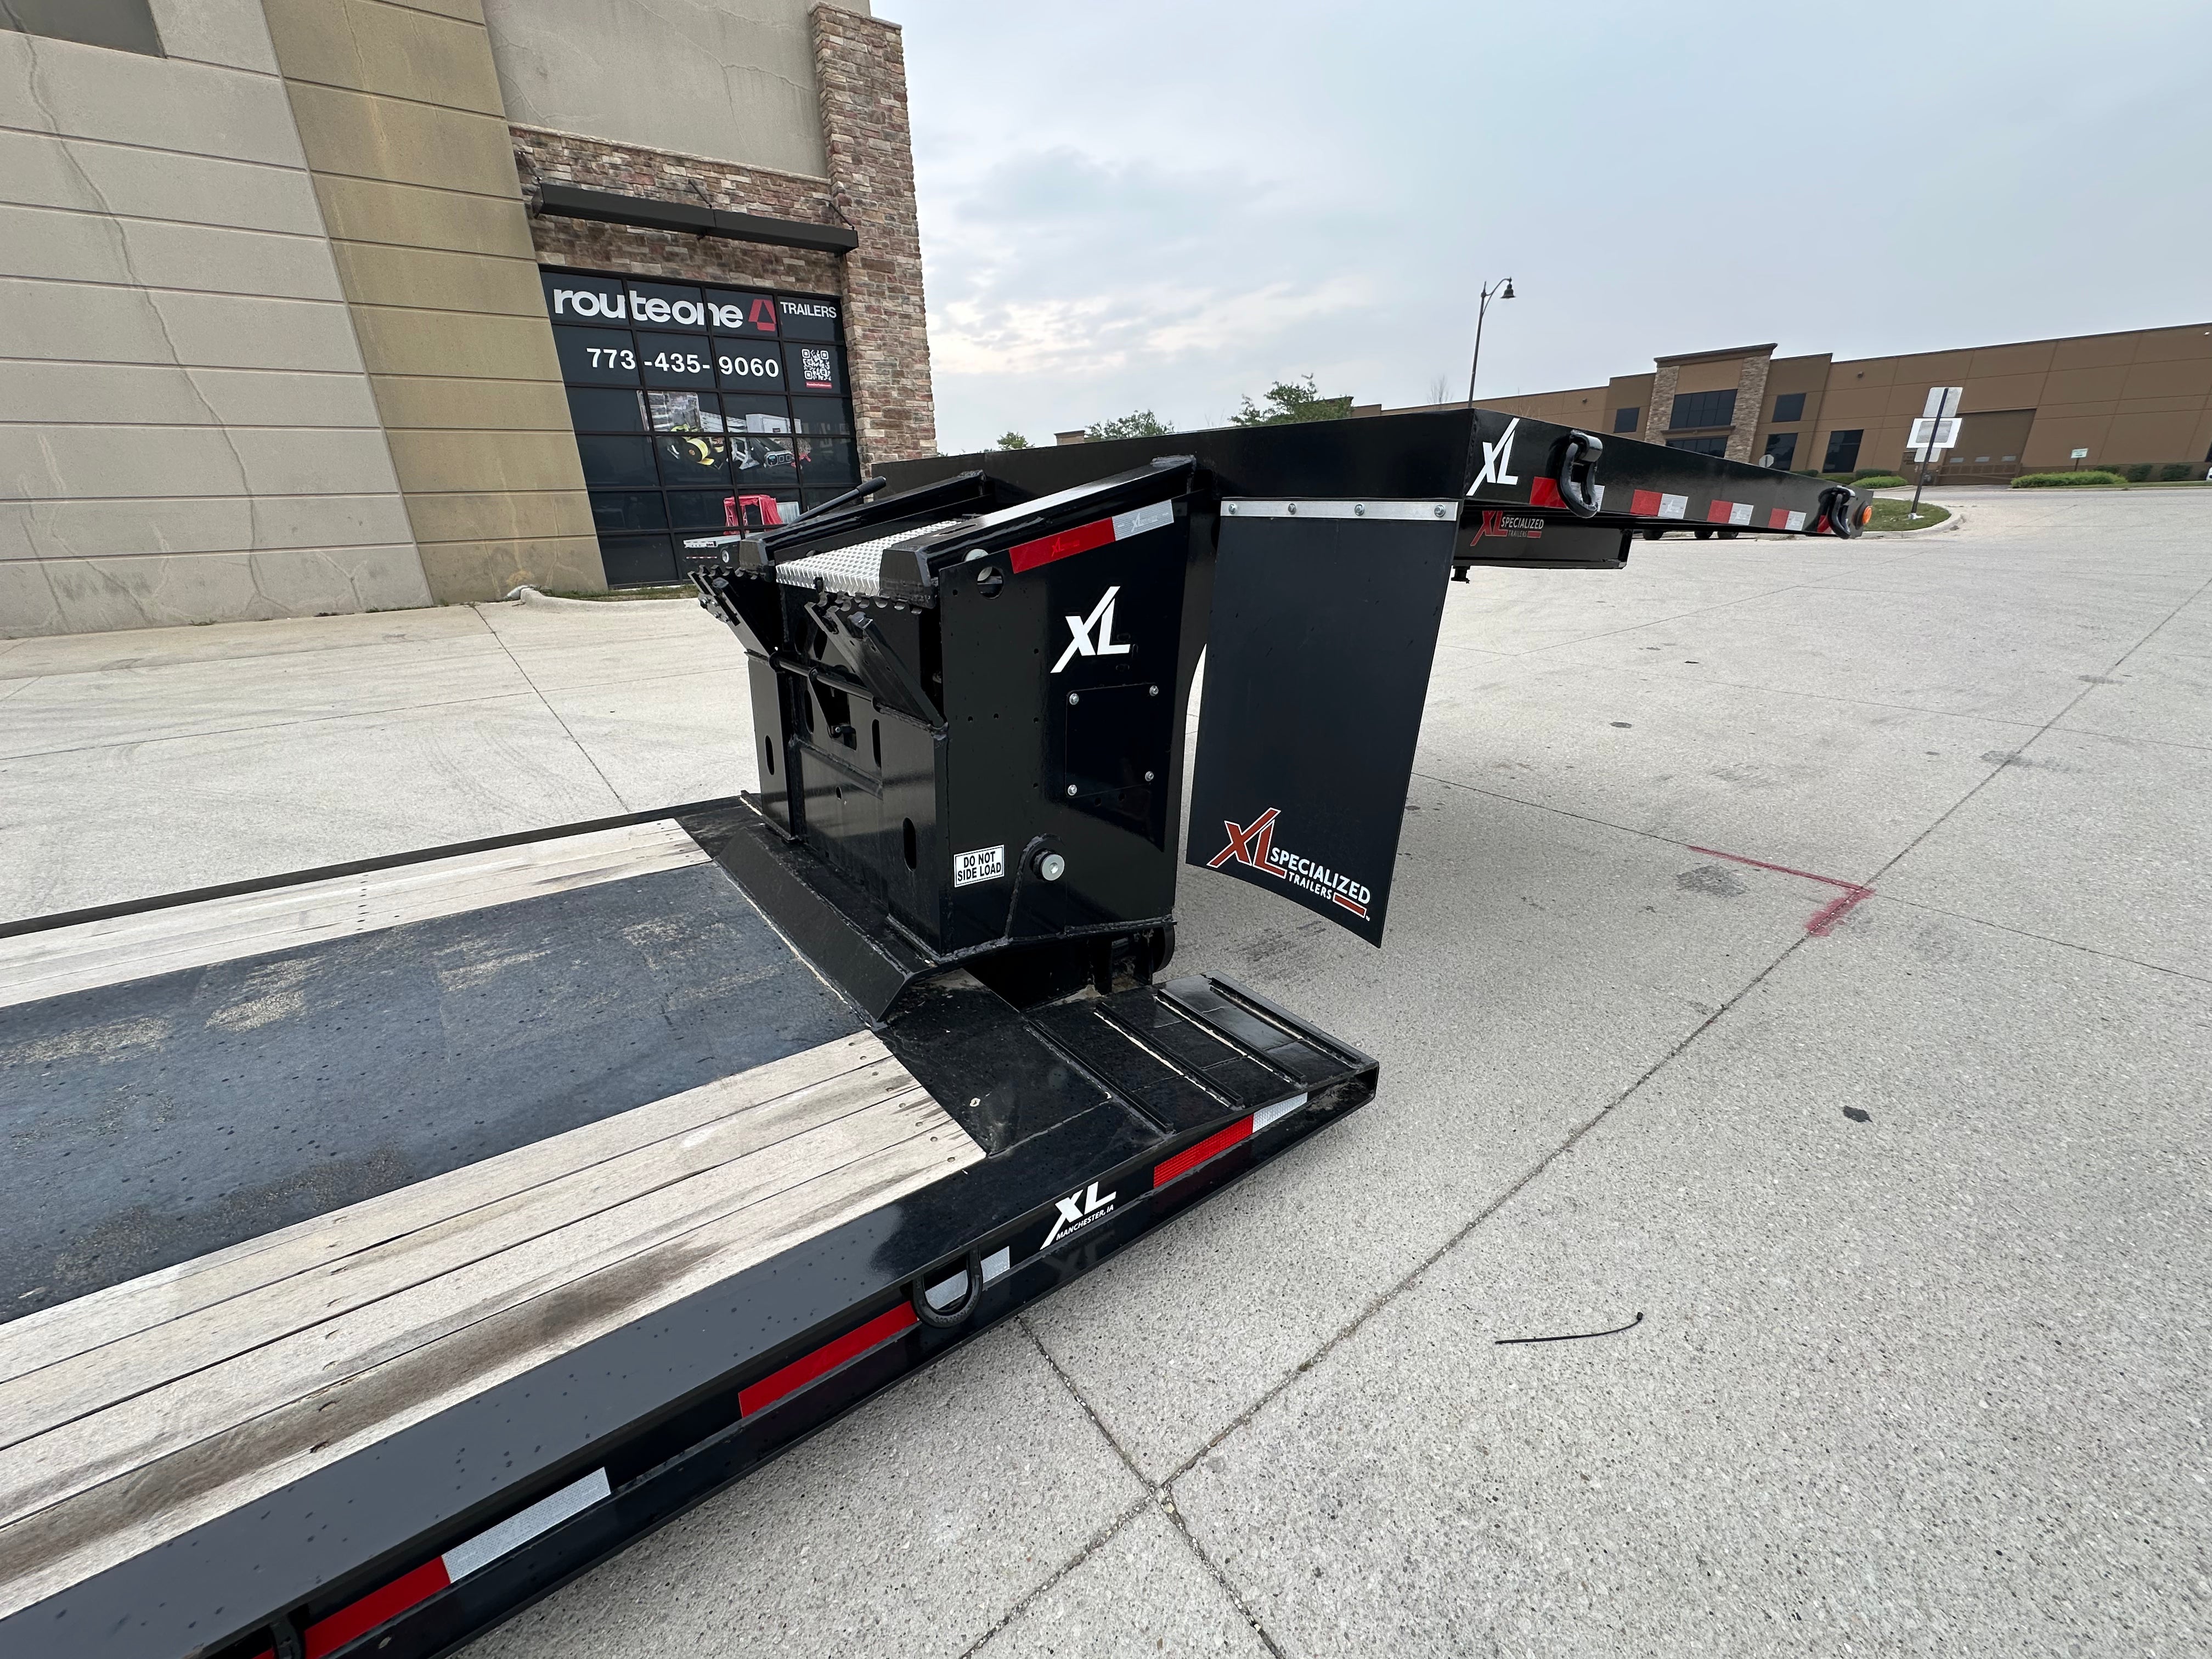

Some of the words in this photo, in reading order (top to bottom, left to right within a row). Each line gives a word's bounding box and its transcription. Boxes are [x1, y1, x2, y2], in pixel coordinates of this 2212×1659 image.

[554, 289, 743, 328] routeone
[780, 301, 837, 319] TRAILERS
[1466, 417, 1520, 496] XL
[1470, 510, 1508, 546] XL
[1501, 517, 1544, 529] SPECIALIZED
[1050, 585, 1131, 674] XL
[963, 856, 976, 868] DO
[978, 851, 996, 865] NOT
[1206, 808, 1287, 879] XL
[957, 866, 977, 882] SIDE
[979, 862, 1001, 877] LOAD
[1270, 848, 1370, 904] SPECIALIZED
[1288, 872, 1332, 900] TRAILERS
[1040, 1181, 1116, 1251] XL
[1056, 1210, 1106, 1240] MANCHESTER,
